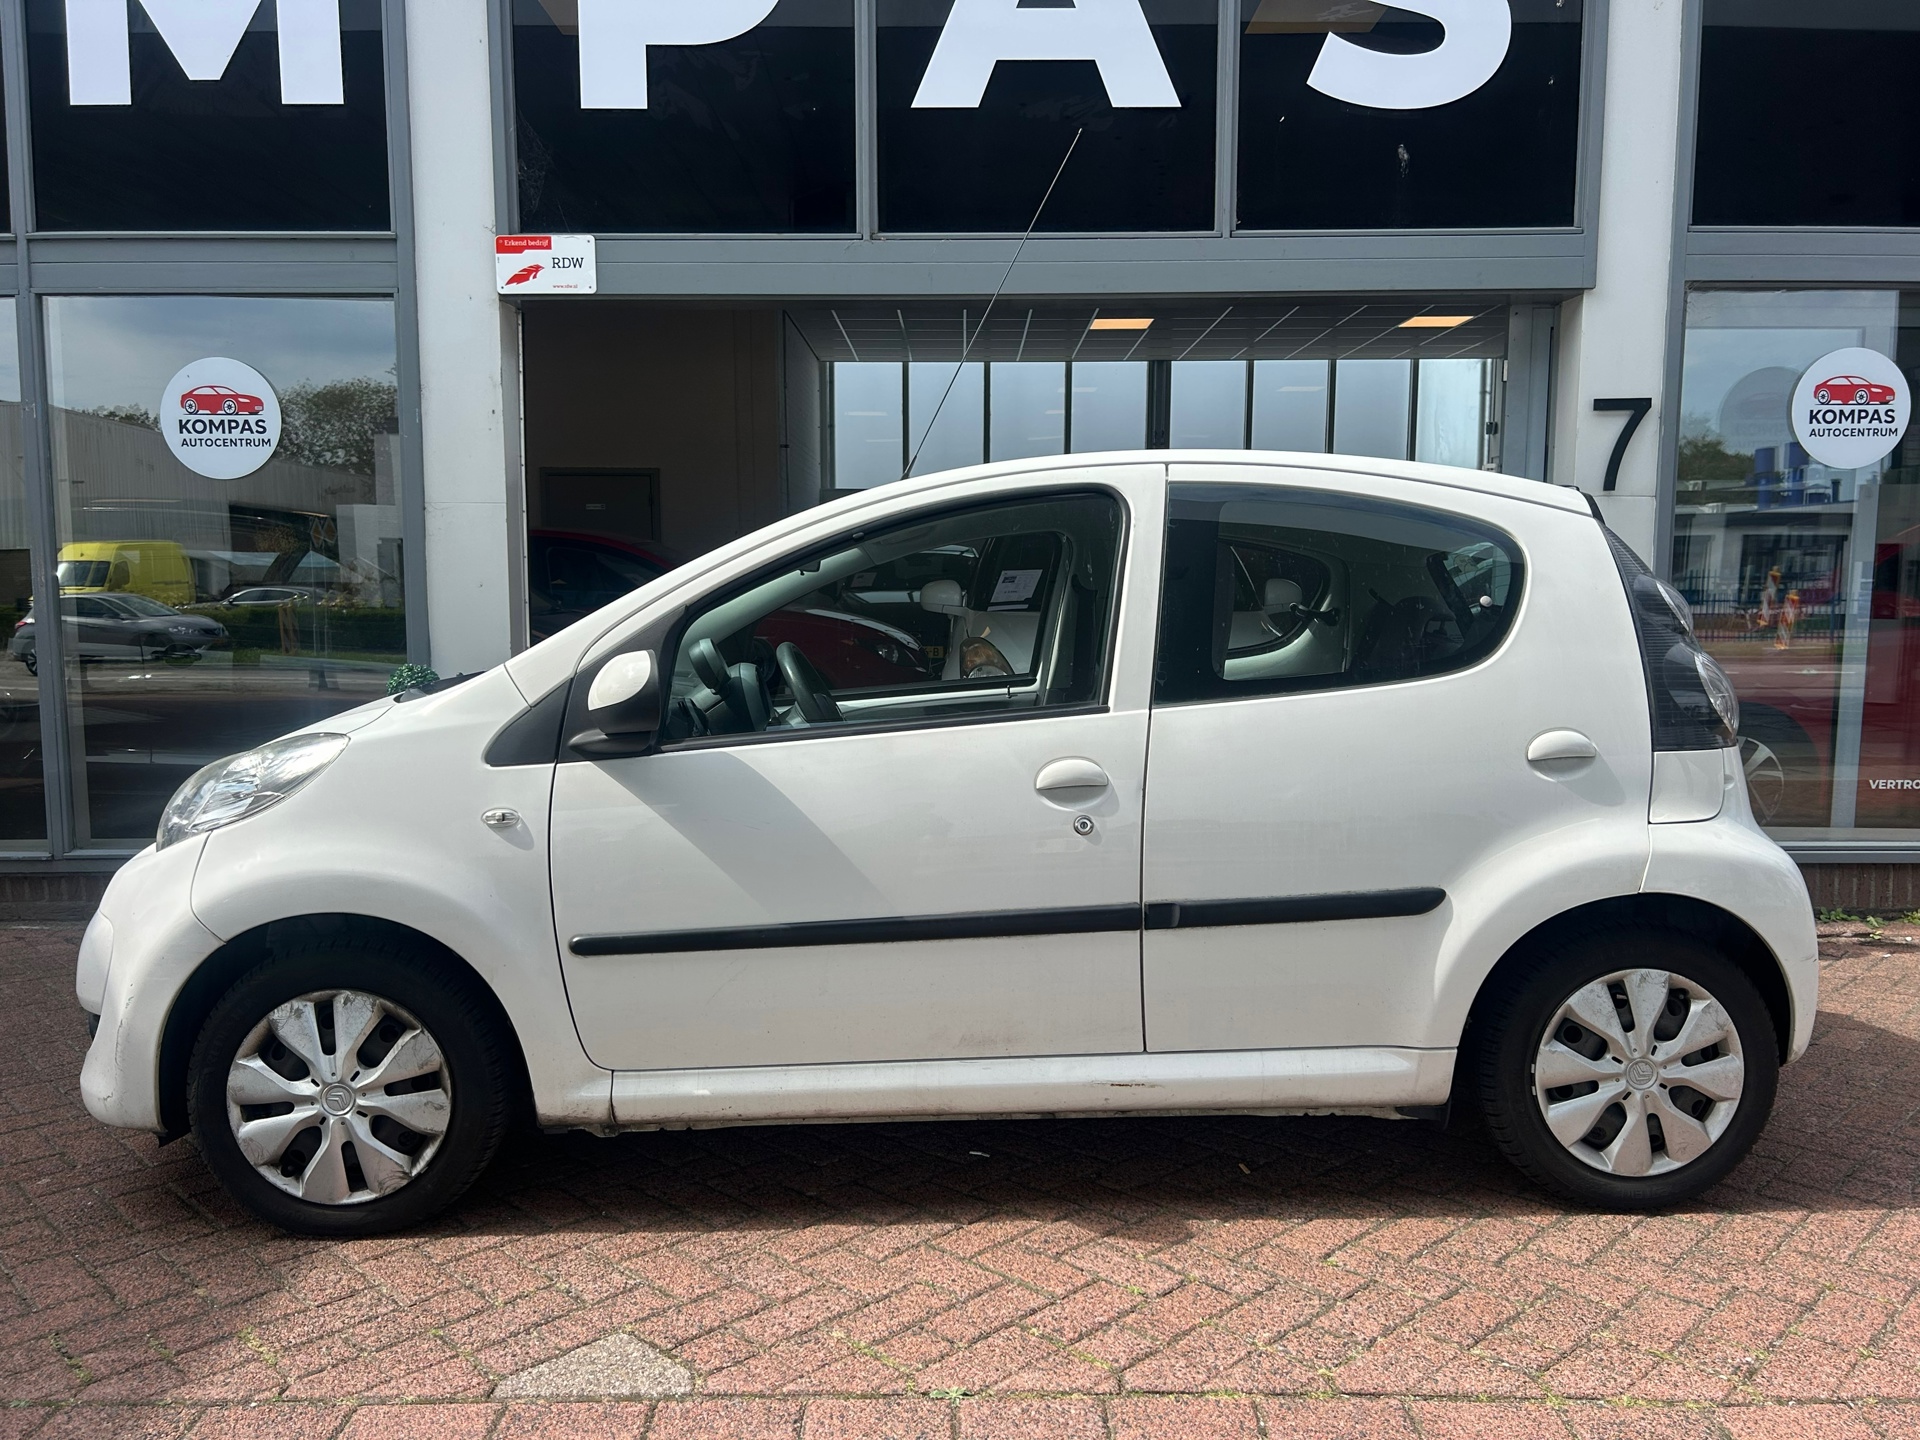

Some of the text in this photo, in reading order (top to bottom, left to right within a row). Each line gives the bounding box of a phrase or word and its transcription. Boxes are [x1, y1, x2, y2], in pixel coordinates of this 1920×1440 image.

[528, 239, 549, 248] bedrijf
[551, 257, 584, 269] RDW
[1808, 408, 1896, 425] KOMPAS
[178, 418, 267, 435] KOMPAS
[1808, 427, 1898, 438] AUTOCENTRUM
[181, 437, 272, 448] AUTOCENTRUM
[1593, 397, 1652, 491] 7
